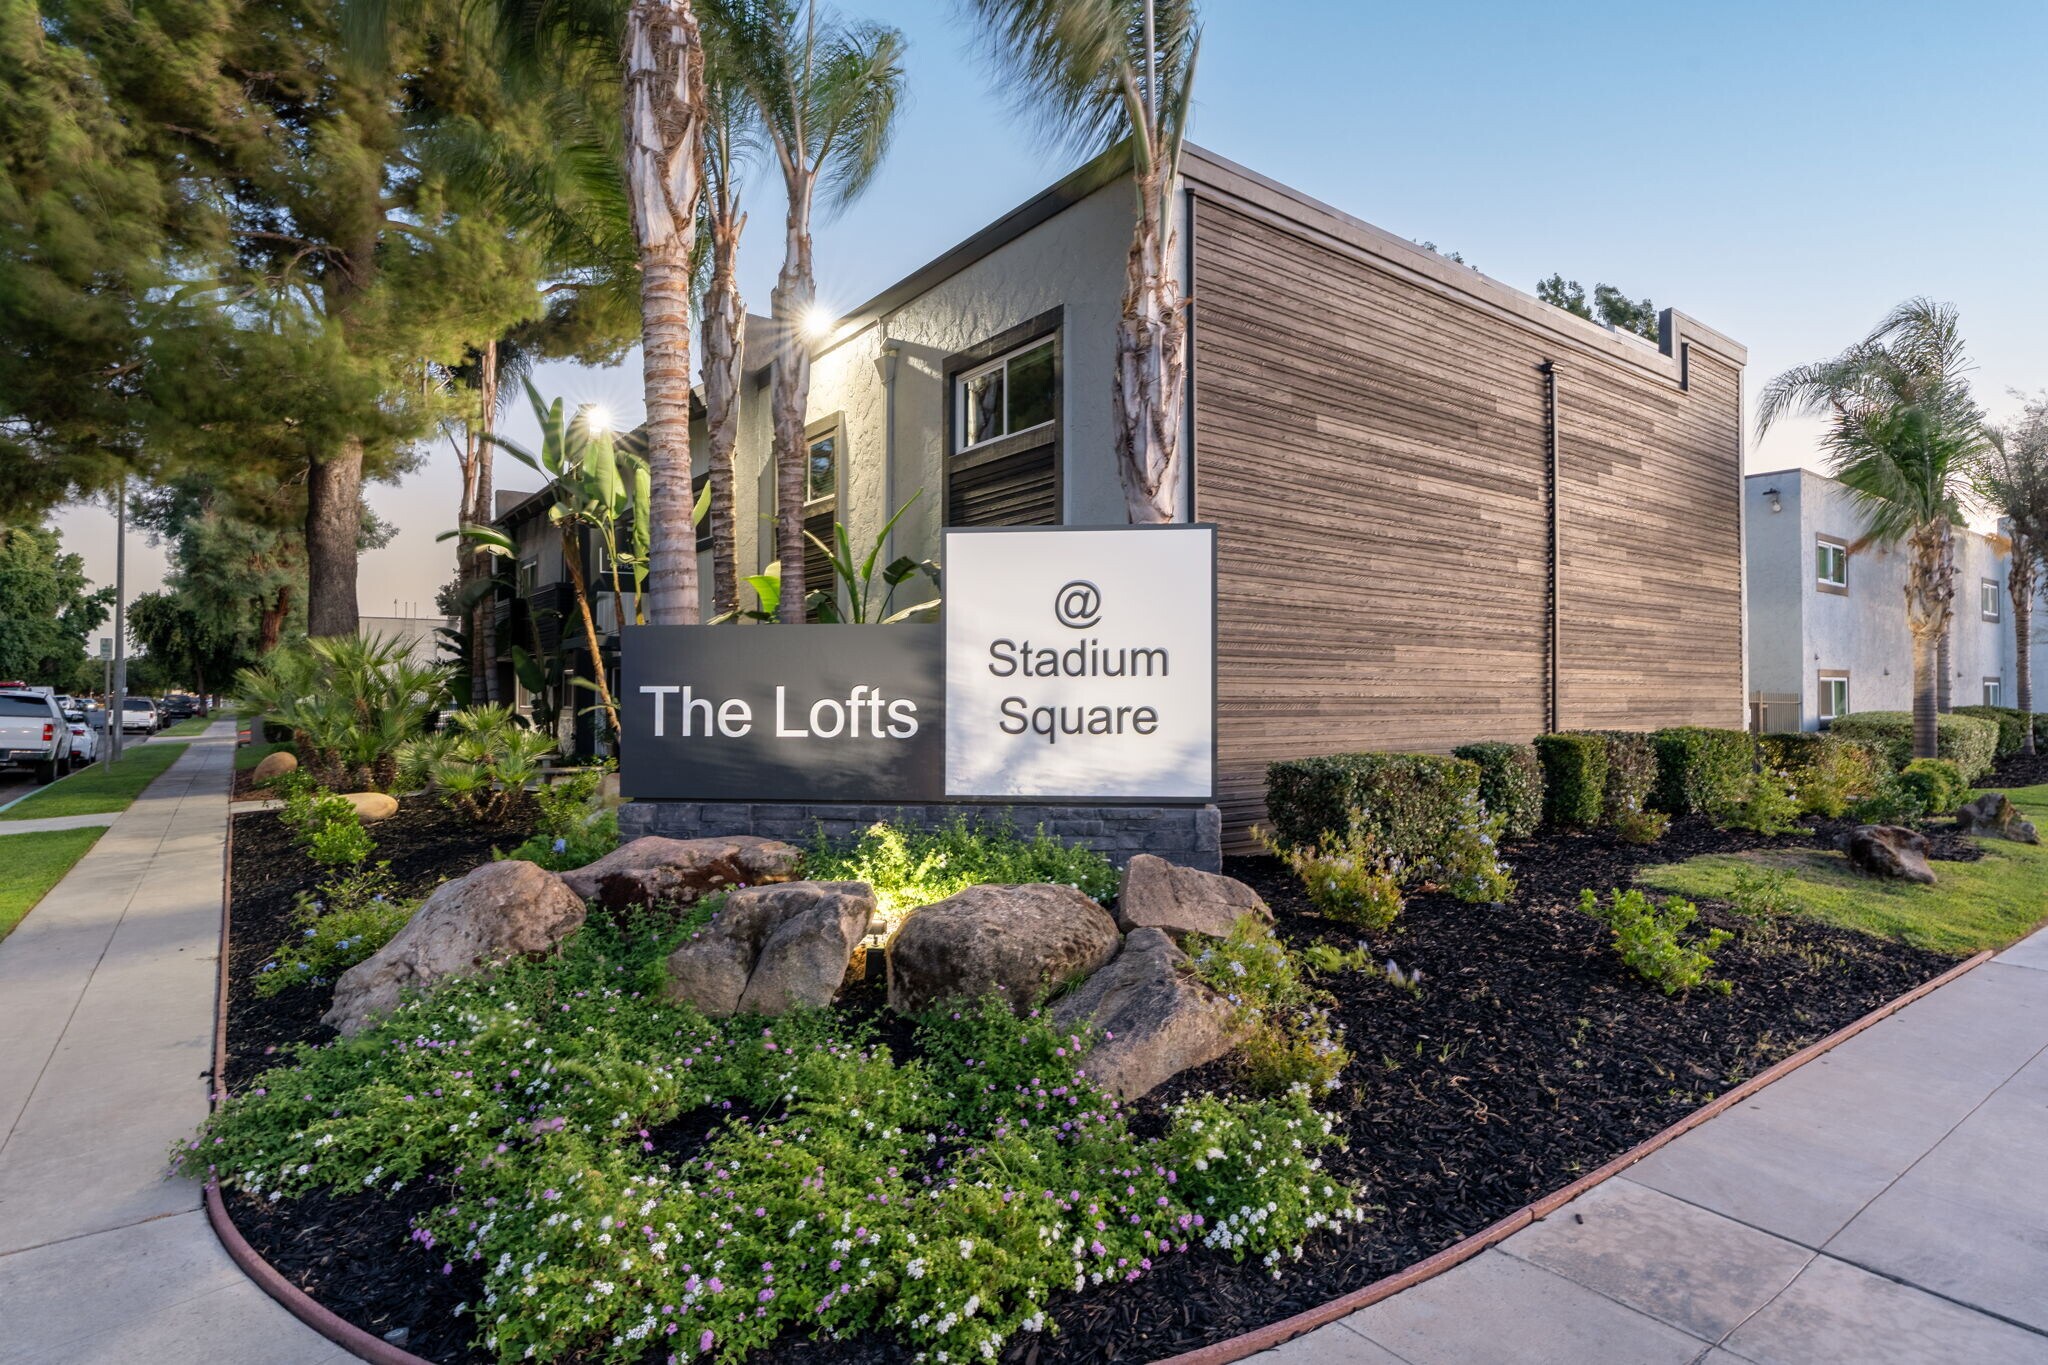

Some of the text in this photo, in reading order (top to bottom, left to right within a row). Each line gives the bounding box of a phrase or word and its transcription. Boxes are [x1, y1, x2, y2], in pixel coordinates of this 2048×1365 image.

[1054, 580, 1102, 630] @
[988, 638, 1169, 678] Stadium
[639, 684, 919, 739] The Lofts
[999, 696, 1159, 745] Square
